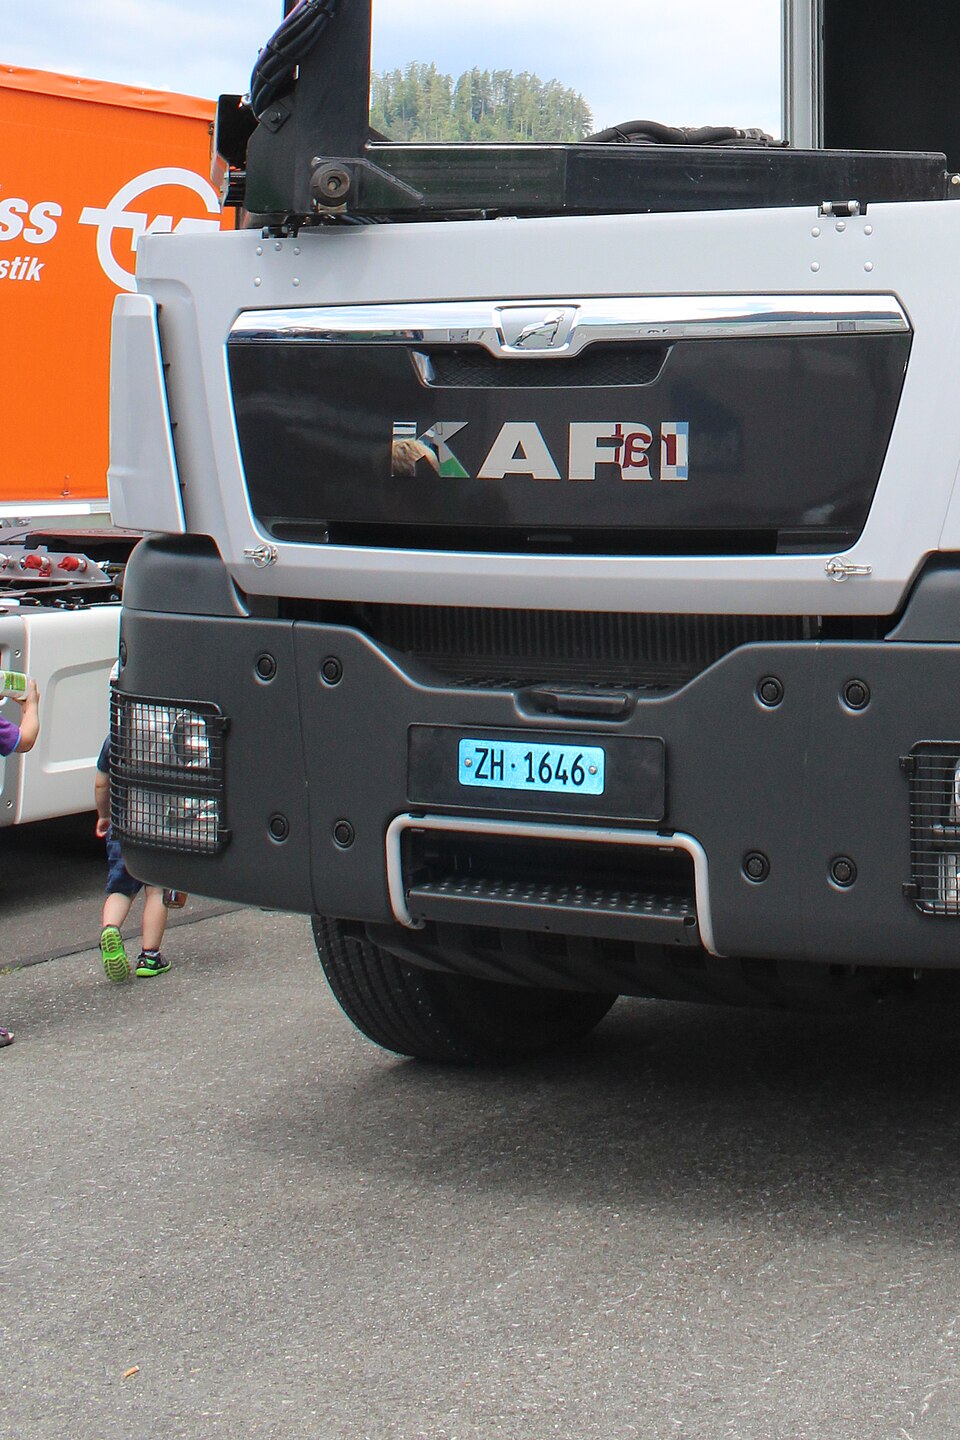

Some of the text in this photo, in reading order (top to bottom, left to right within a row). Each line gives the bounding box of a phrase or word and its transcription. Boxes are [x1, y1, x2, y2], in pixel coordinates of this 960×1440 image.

[391, 421, 690, 481] KARI
[474, 747, 586, 786] ZH 1646
